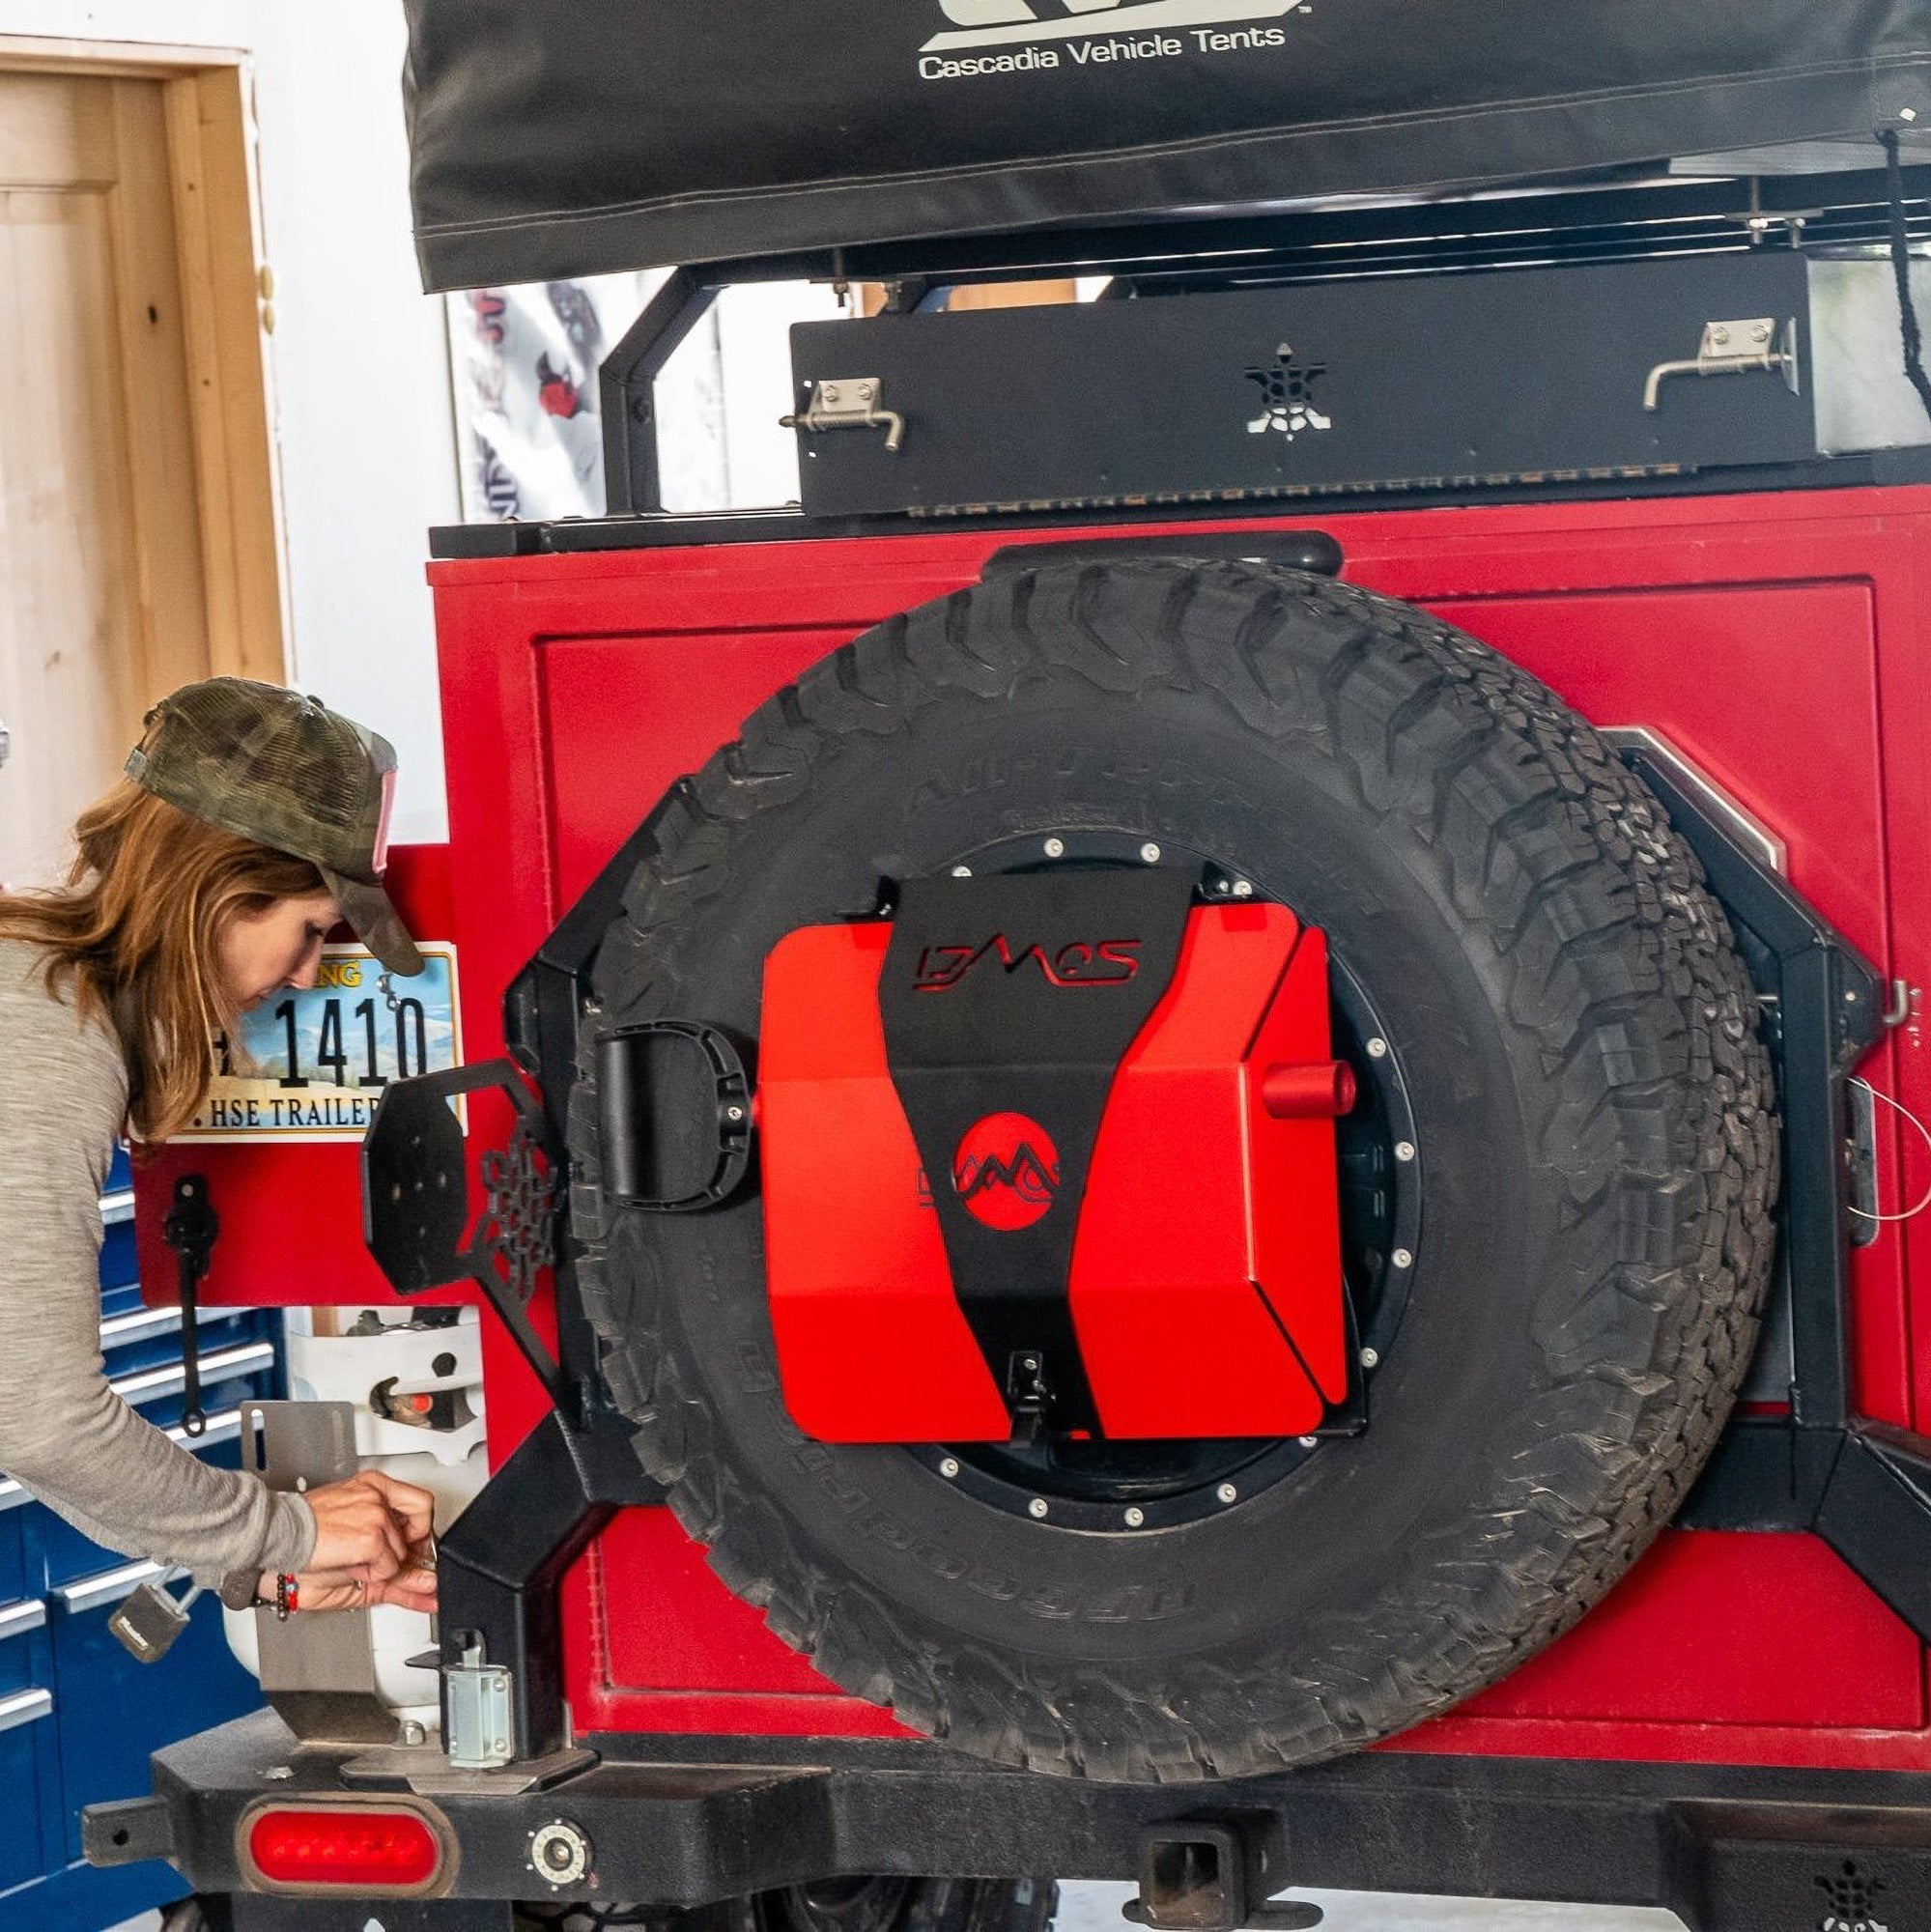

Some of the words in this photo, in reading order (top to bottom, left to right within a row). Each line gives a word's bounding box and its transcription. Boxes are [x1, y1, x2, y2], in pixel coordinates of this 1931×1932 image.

[919, 46, 1059, 79] Cascadia
[1066, 34, 1182, 65] Vehicle
[1189, 27, 1286, 54] Tents
[316, 961, 362, 987] NG
[275, 997, 427, 1088] 1410
[211, 1098, 261, 1127] HSE
